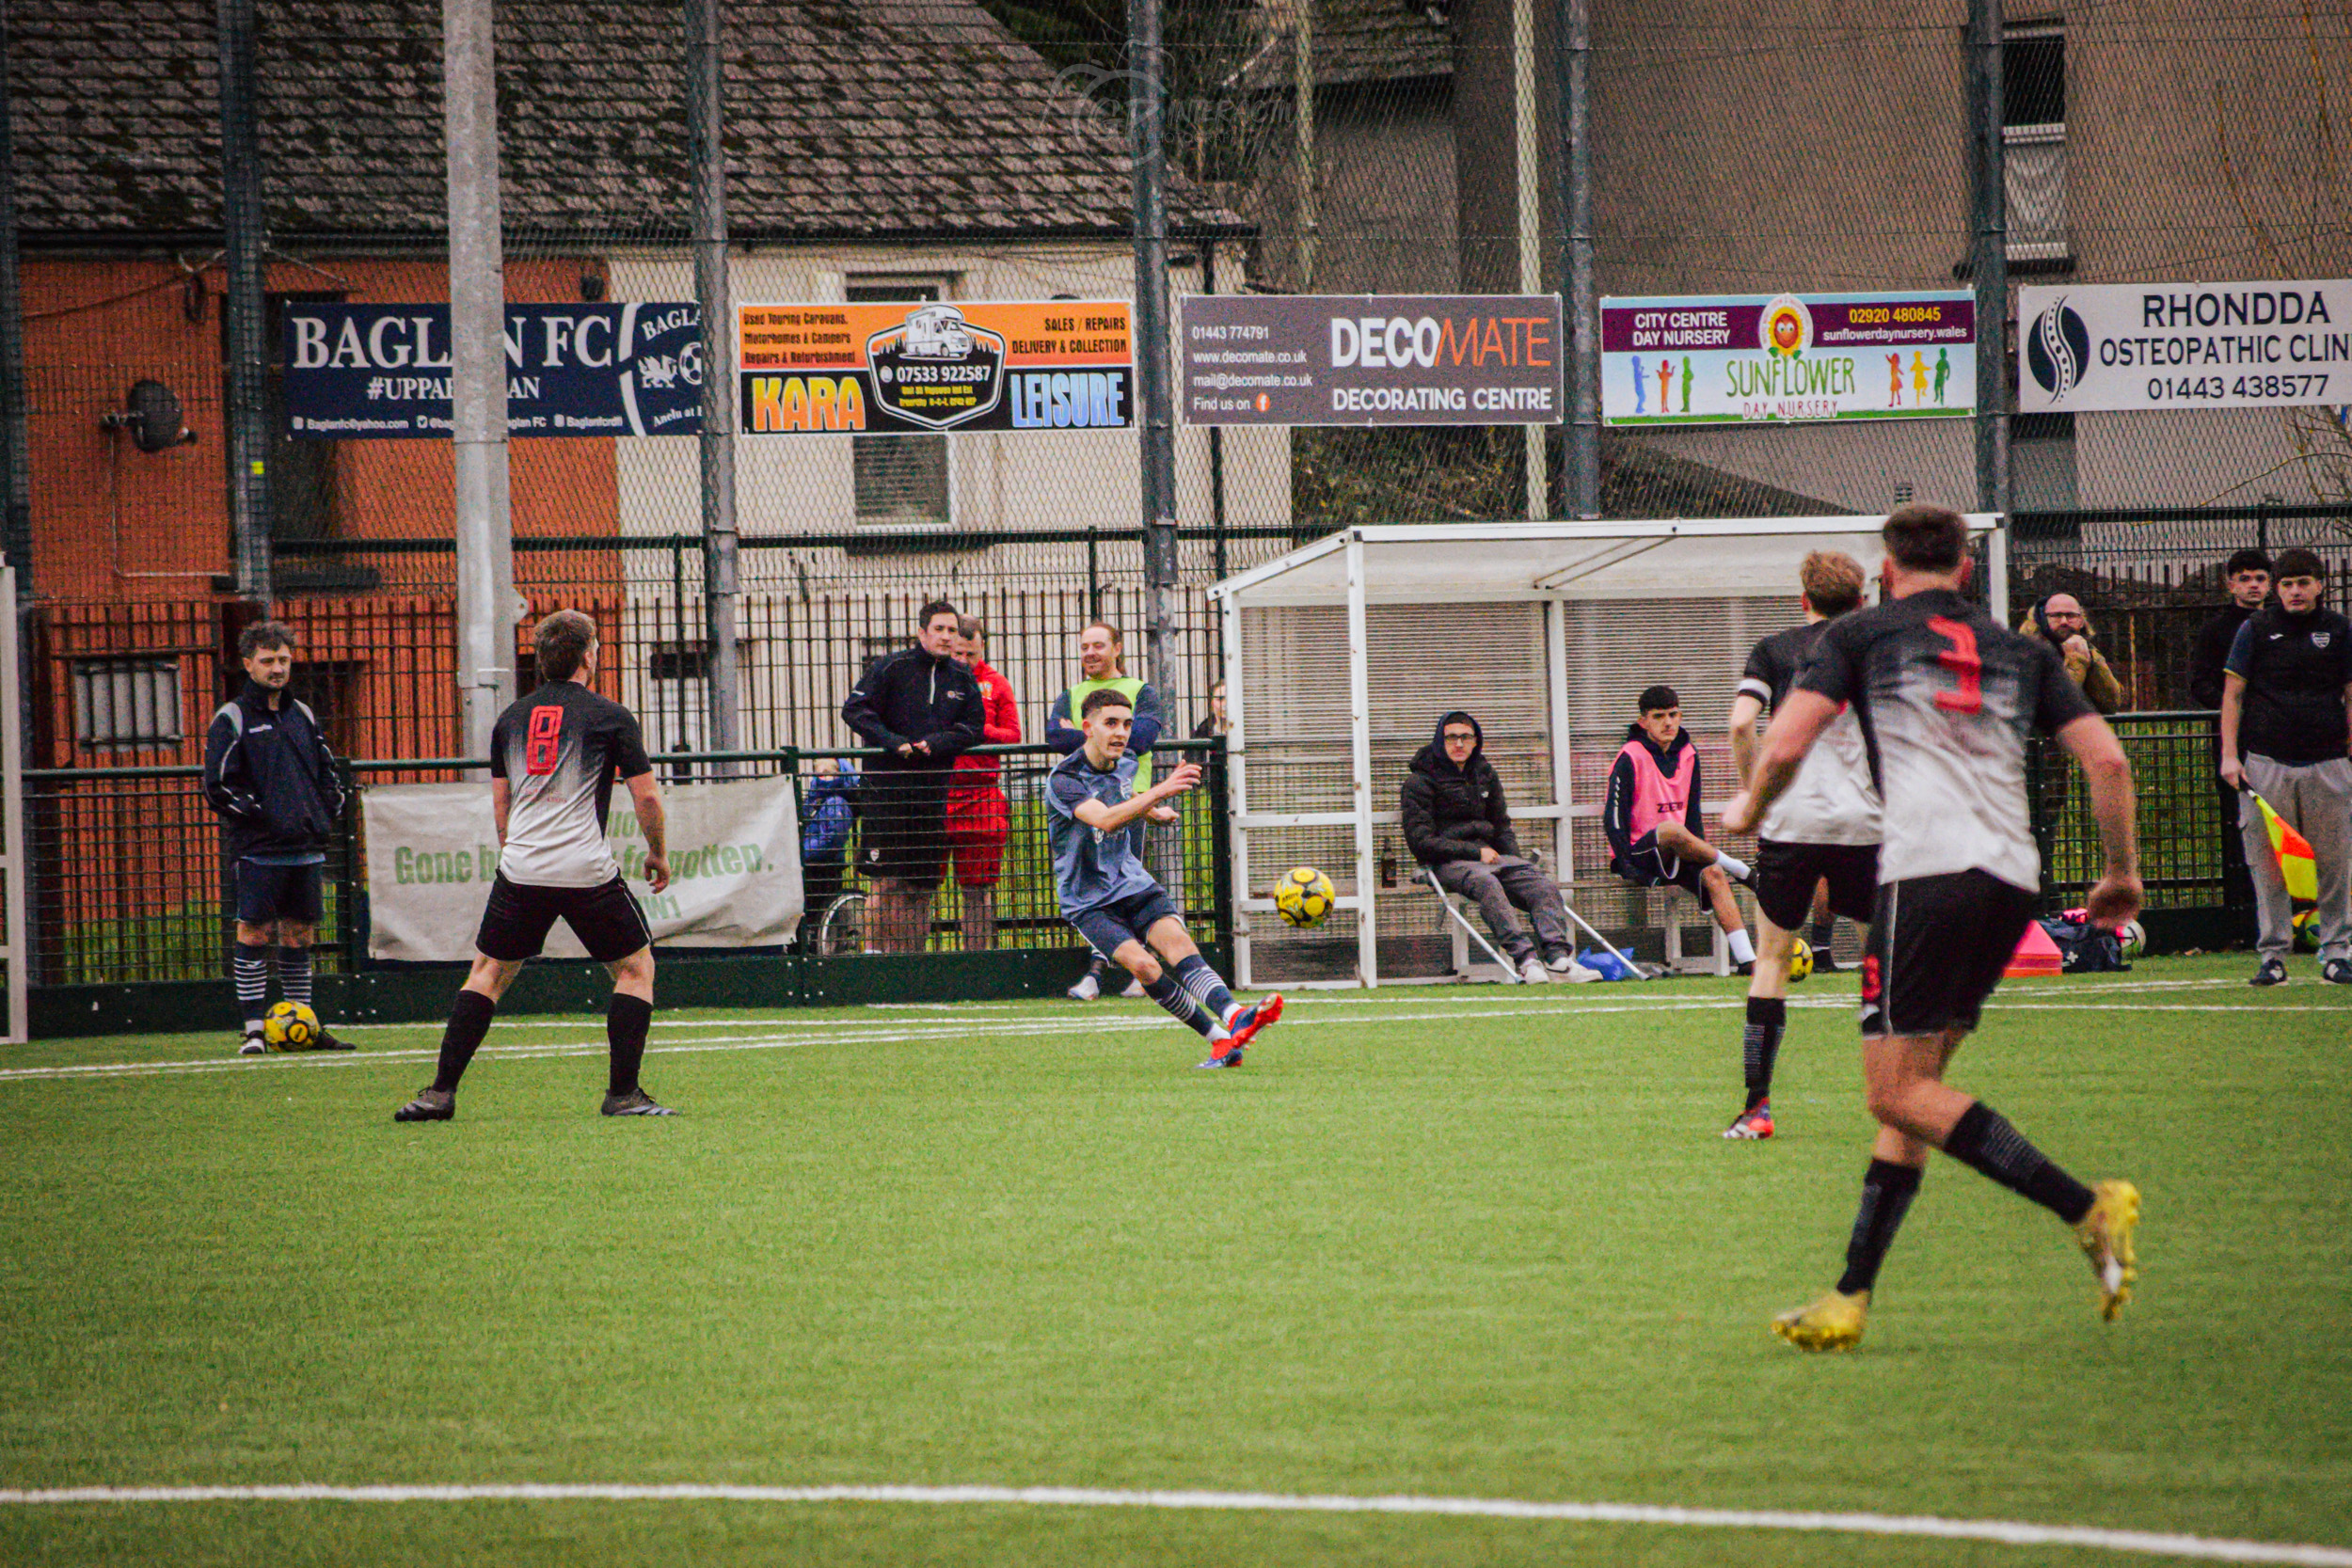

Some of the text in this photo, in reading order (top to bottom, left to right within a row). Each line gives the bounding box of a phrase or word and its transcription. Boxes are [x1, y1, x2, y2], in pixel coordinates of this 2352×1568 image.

[1635, 311, 1728, 328] CITY CENTRE
[1849, 307, 1942, 324] 02920 480845
[2143, 291, 2331, 327] RHONDDA
[1044, 318, 1074, 331] SALES
[1085, 317, 1125, 331] REPAIRS
[1192, 325, 1269, 340] 01443 774791
[1823, 326, 1967, 342] sunflowerdaynursery.wales
[291, 315, 612, 369] BAGLN FC
[1011, 339, 1127, 354] DELIVERY & COLLECTION
[1331, 316, 1550, 368] DECOMATE
[1632, 329, 1731, 346] DAY NURSERY
[1193, 349, 1308, 364] www.decomate.co.uk
[2100, 333, 2352, 367] OSTEOPATHIC CLIN
[897, 364, 992, 383] 07533 922587
[1193, 372, 1313, 390] mail@decomate.co.uk
[1726, 357, 1855, 398] SUNFLOWER
[367, 376, 541, 400] #UPPAAN
[2148, 374, 2328, 400] 01443 438577
[752, 376, 866, 432] KARA
[1010, 372, 1125, 428] LEISURE
[1193, 397, 1218, 410] Find
[1220, 400, 1234, 410] us
[1236, 400, 1251, 410] on
[1332, 388, 1552, 411] DECORATING CENTRE
[1743, 400, 1838, 419] DAY NURSERY
[1929, 614, 1982, 715] 3
[527, 705, 564, 776] 8
[394, 846, 473, 885] Gone
[622, 843, 775, 885] fogotten.
